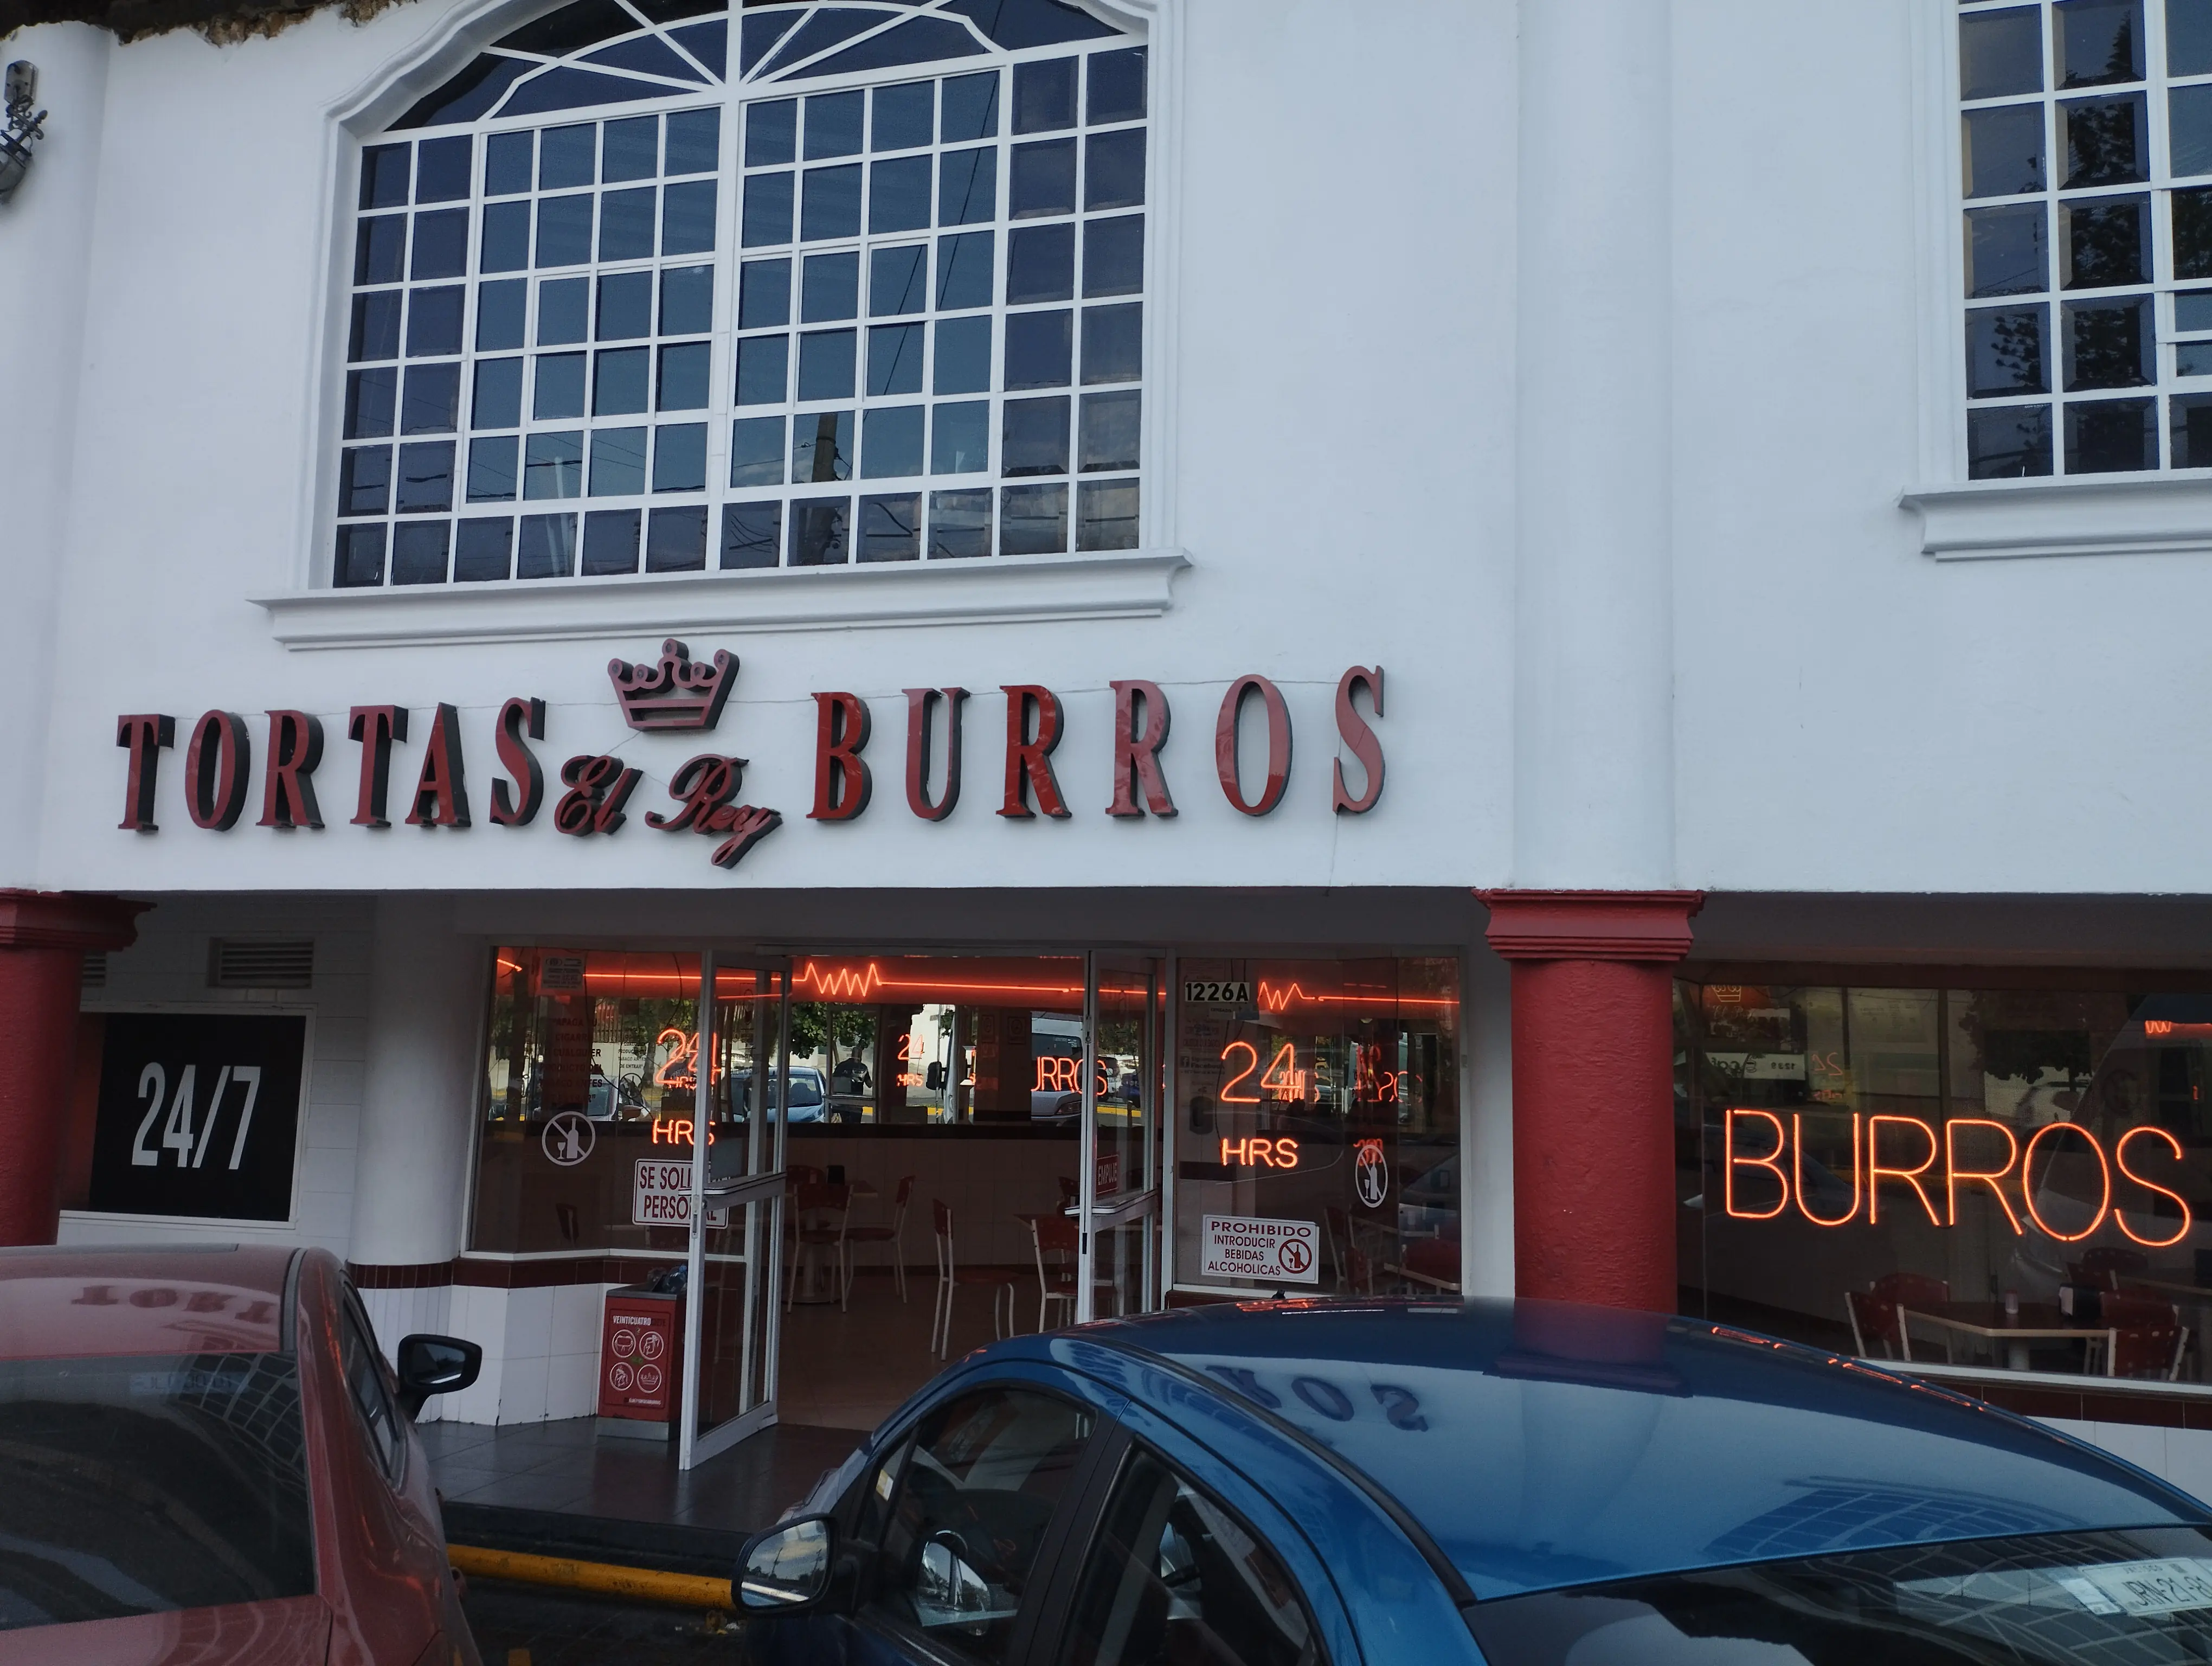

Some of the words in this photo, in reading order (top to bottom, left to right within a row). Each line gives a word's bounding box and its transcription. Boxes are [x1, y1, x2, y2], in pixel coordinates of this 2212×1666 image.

[805, 665, 1385, 822] BURROS
[117, 696, 546, 832] TORTAS
[554, 754, 644, 837] El
[645, 753, 782, 869] Rey
[1186, 983, 1249, 1001] 1226A
[655, 1028, 721, 1085] 24
[1220, 1041, 1302, 1103] 24
[131, 1061, 261, 1170] 24/7
[1221, 1138, 1298, 1168] HRS
[640, 1166, 655, 1189] SE
[660, 1167, 693, 1190] SOLI
[1725, 1109, 2191, 1247] BURROS
[644, 1195, 717, 1221] PERSOL
[1211, 1221, 1311, 1238] PROHIBIDO
[1214, 1234, 1276, 1248] INTRODUCIR
[1207, 1260, 1281, 1276] ALCOHOLICAS
[1225, 1248, 1264, 1261] BEBIDAS
